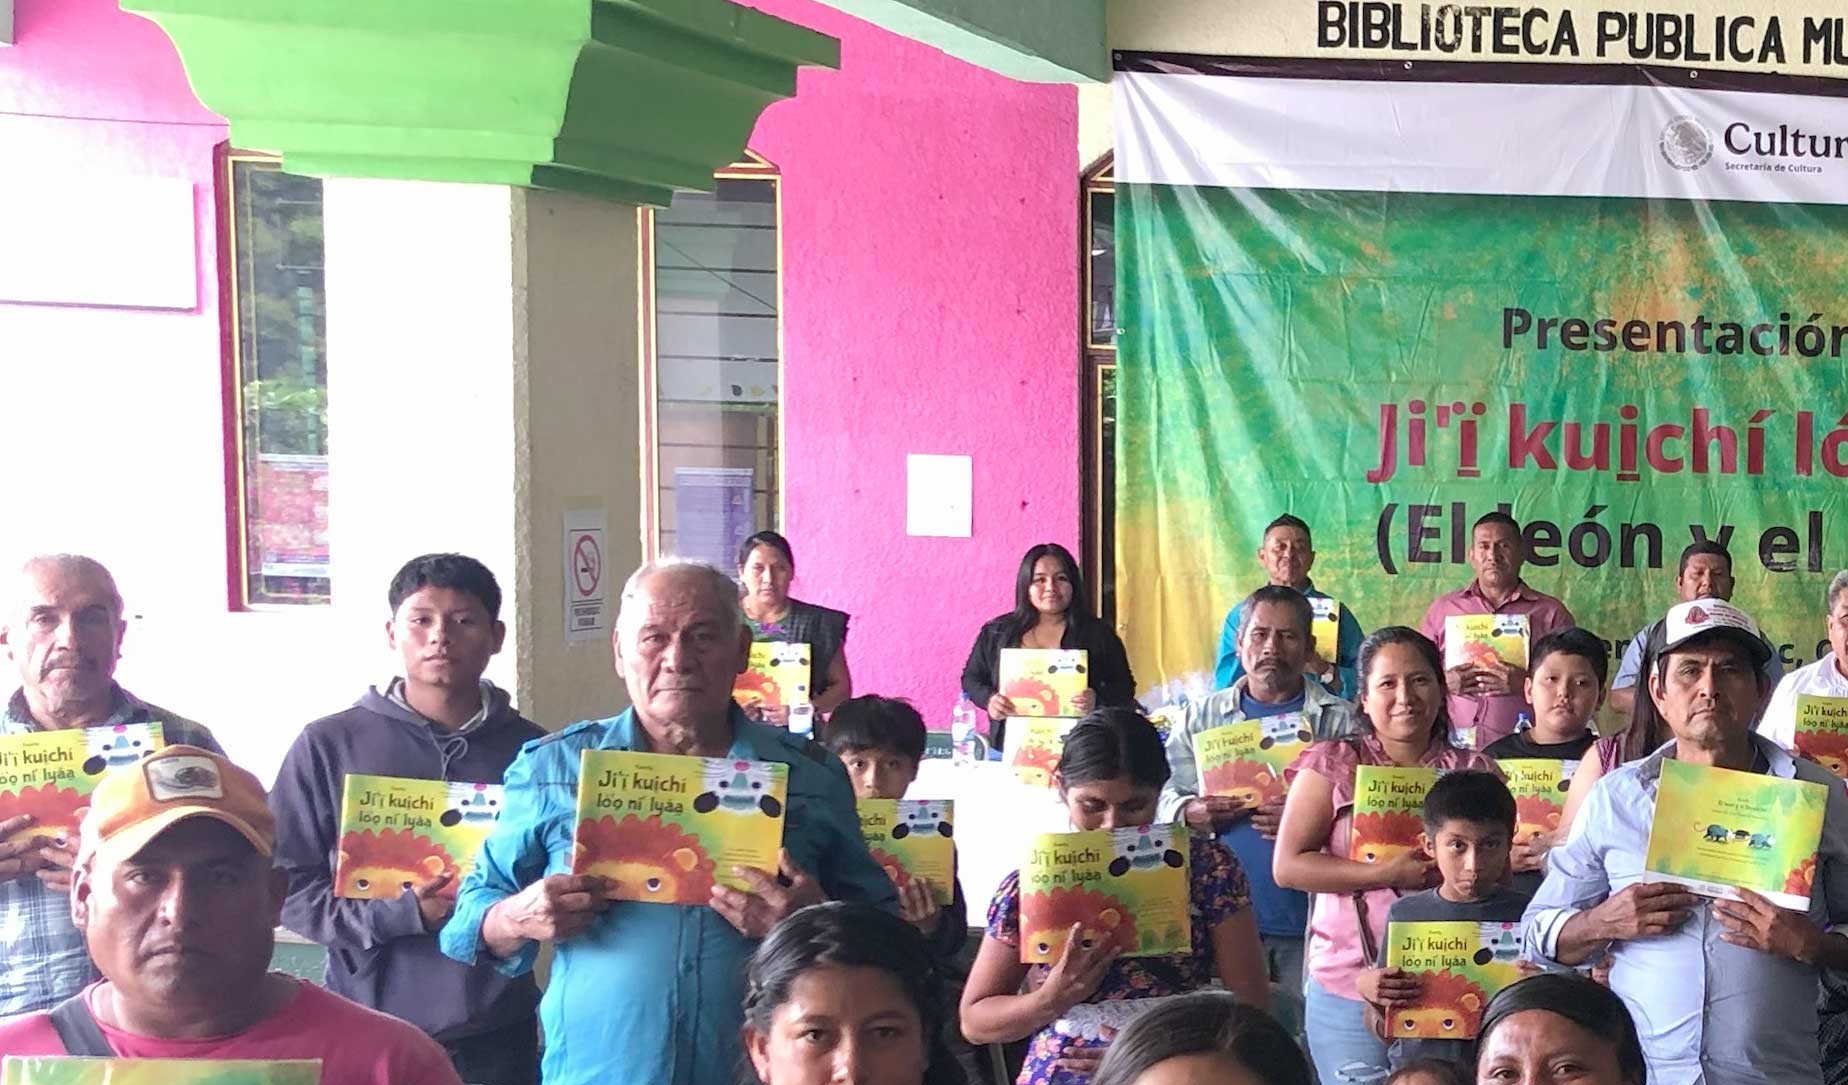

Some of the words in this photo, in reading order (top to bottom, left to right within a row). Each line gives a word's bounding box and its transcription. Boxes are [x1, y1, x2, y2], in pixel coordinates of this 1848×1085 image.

[1317, 0, 1580, 56] BIBLIOTECA
[1597, 9, 1787, 65] PUBLICA
[1376, 502, 1467, 575] (El
[1498, 503, 1664, 568] eón
[1758, 510, 1825, 573] el
